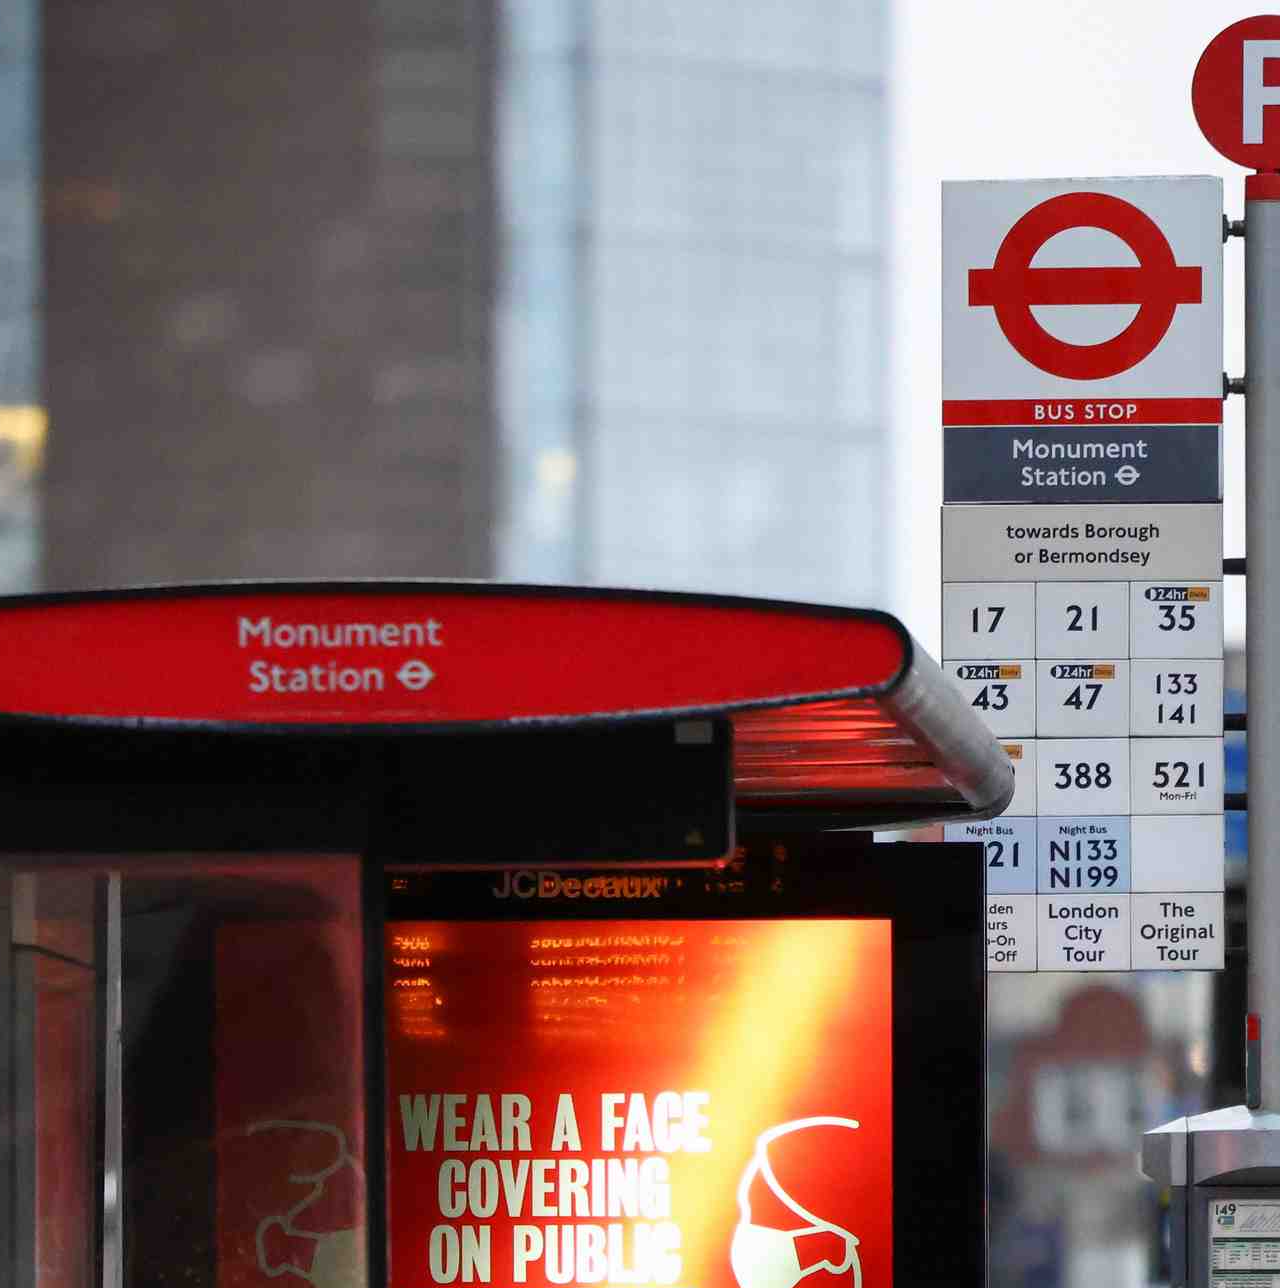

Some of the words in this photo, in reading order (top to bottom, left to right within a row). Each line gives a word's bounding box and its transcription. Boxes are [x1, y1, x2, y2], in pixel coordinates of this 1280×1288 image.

[1034, 404, 1075, 420] BUS
[1084, 403, 1137, 420] STOP
[1012, 439, 1148, 459] Monument
[1021, 466, 1106, 487] Station
[1007, 523, 1079, 540] towards
[1084, 523, 1160, 543] Borough
[1014, 552, 1033, 564] or
[1039, 549, 1150, 568] Bermondsey
[1157, 588, 1186, 601] 24hr
[972, 607, 1006, 633] 17
[1066, 605, 1098, 632] 21
[1158, 605, 1196, 631] 35
[238, 616, 443, 648] Monument
[249, 659, 384, 693] Station
[970, 667, 998, 679] 24hr
[1063, 666, 1091, 679] 24hr
[1156, 673, 1197, 694] 133
[972, 684, 1009, 711] 43
[1063, 684, 1104, 710] 47
[1157, 704, 1196, 724] 141
[1054, 763, 1112, 789] 388
[1152, 761, 1205, 788] 521
[1159, 791, 1197, 802] Mon-Fri
[966, 825, 993, 837] Night
[996, 826, 1014, 835] Bus
[1059, 825, 1087, 837] Night
[1089, 825, 1107, 834] Bus
[987, 841, 1019, 868] 21
[1050, 840, 1118, 862] N133
[493, 870, 662, 899] JCDecaux
[1050, 866, 1119, 889] N199
[989, 904, 1013, 915] den
[1049, 904, 1119, 919] London
[1159, 903, 1195, 918] The
[987, 921, 1008, 930] urs
[1065, 925, 1102, 943] City
[1141, 923, 1215, 943] Original
[986, 935, 1016, 946] -On
[989, 950, 1018, 962] -Off
[1063, 947, 1105, 962] Tour
[1157, 945, 1199, 962] Tour
[400, 1094, 531, 1152] WEAR
[551, 1094, 581, 1152] A
[602, 1091, 711, 1153] FACE
[439, 1160, 670, 1218] COVERING
[1215, 1203, 1236, 1215] 149
[429, 1224, 490, 1282] ON
[514, 1223, 682, 1284] PUBLIC
